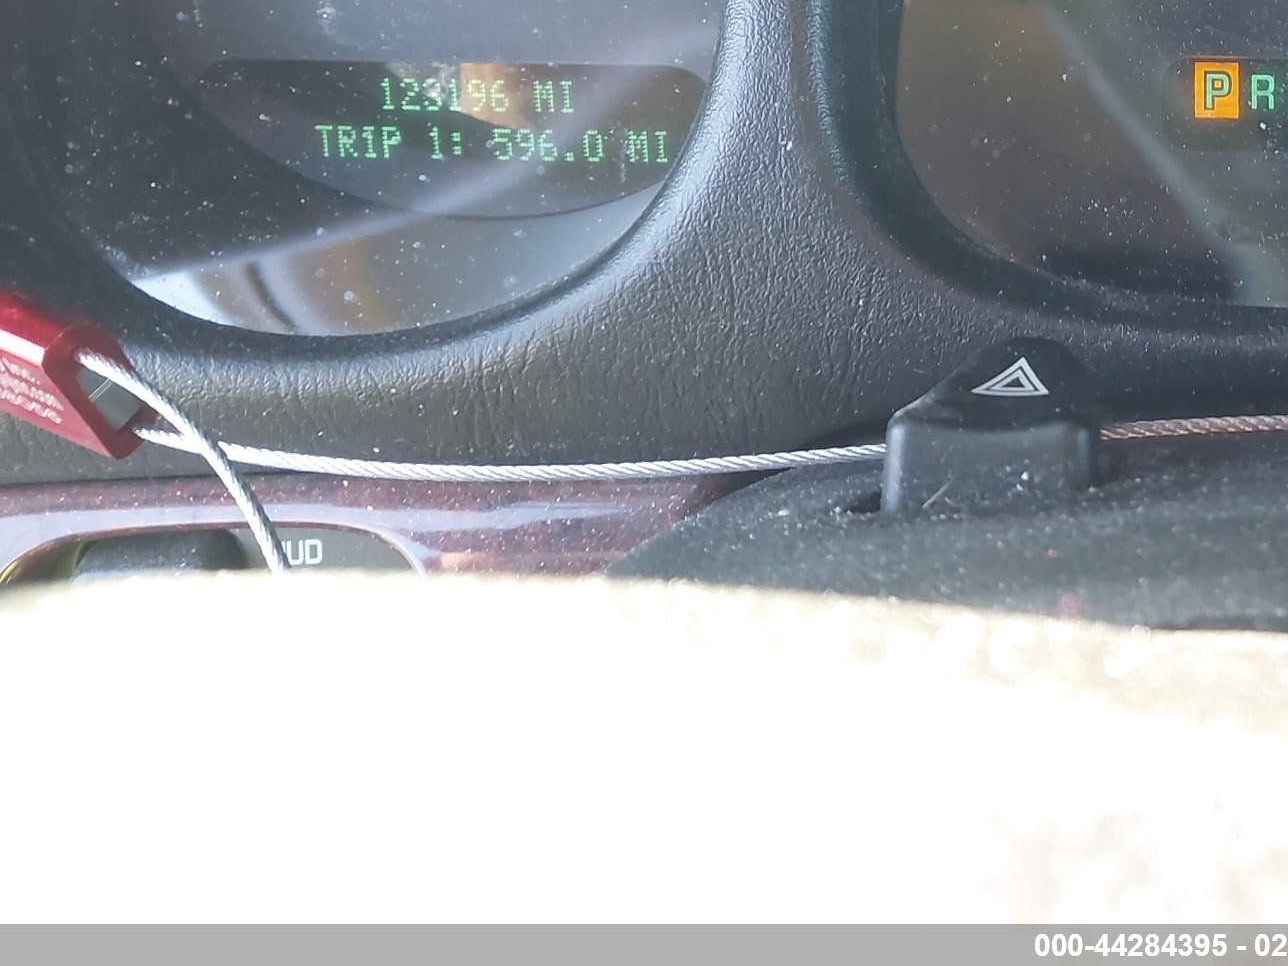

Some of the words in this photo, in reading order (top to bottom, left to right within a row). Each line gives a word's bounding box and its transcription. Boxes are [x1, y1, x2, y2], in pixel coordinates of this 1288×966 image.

[533, 80, 575, 113] MI
[1204, 73, 1231, 110] P
[1249, 74, 1276, 111] R
[314, 124, 402, 159] TRIP
[430, 126, 463, 161] 1:
[493, 128, 604, 163] 596.0
[627, 129, 670, 163] MI
[280, 538, 323, 566] UD
